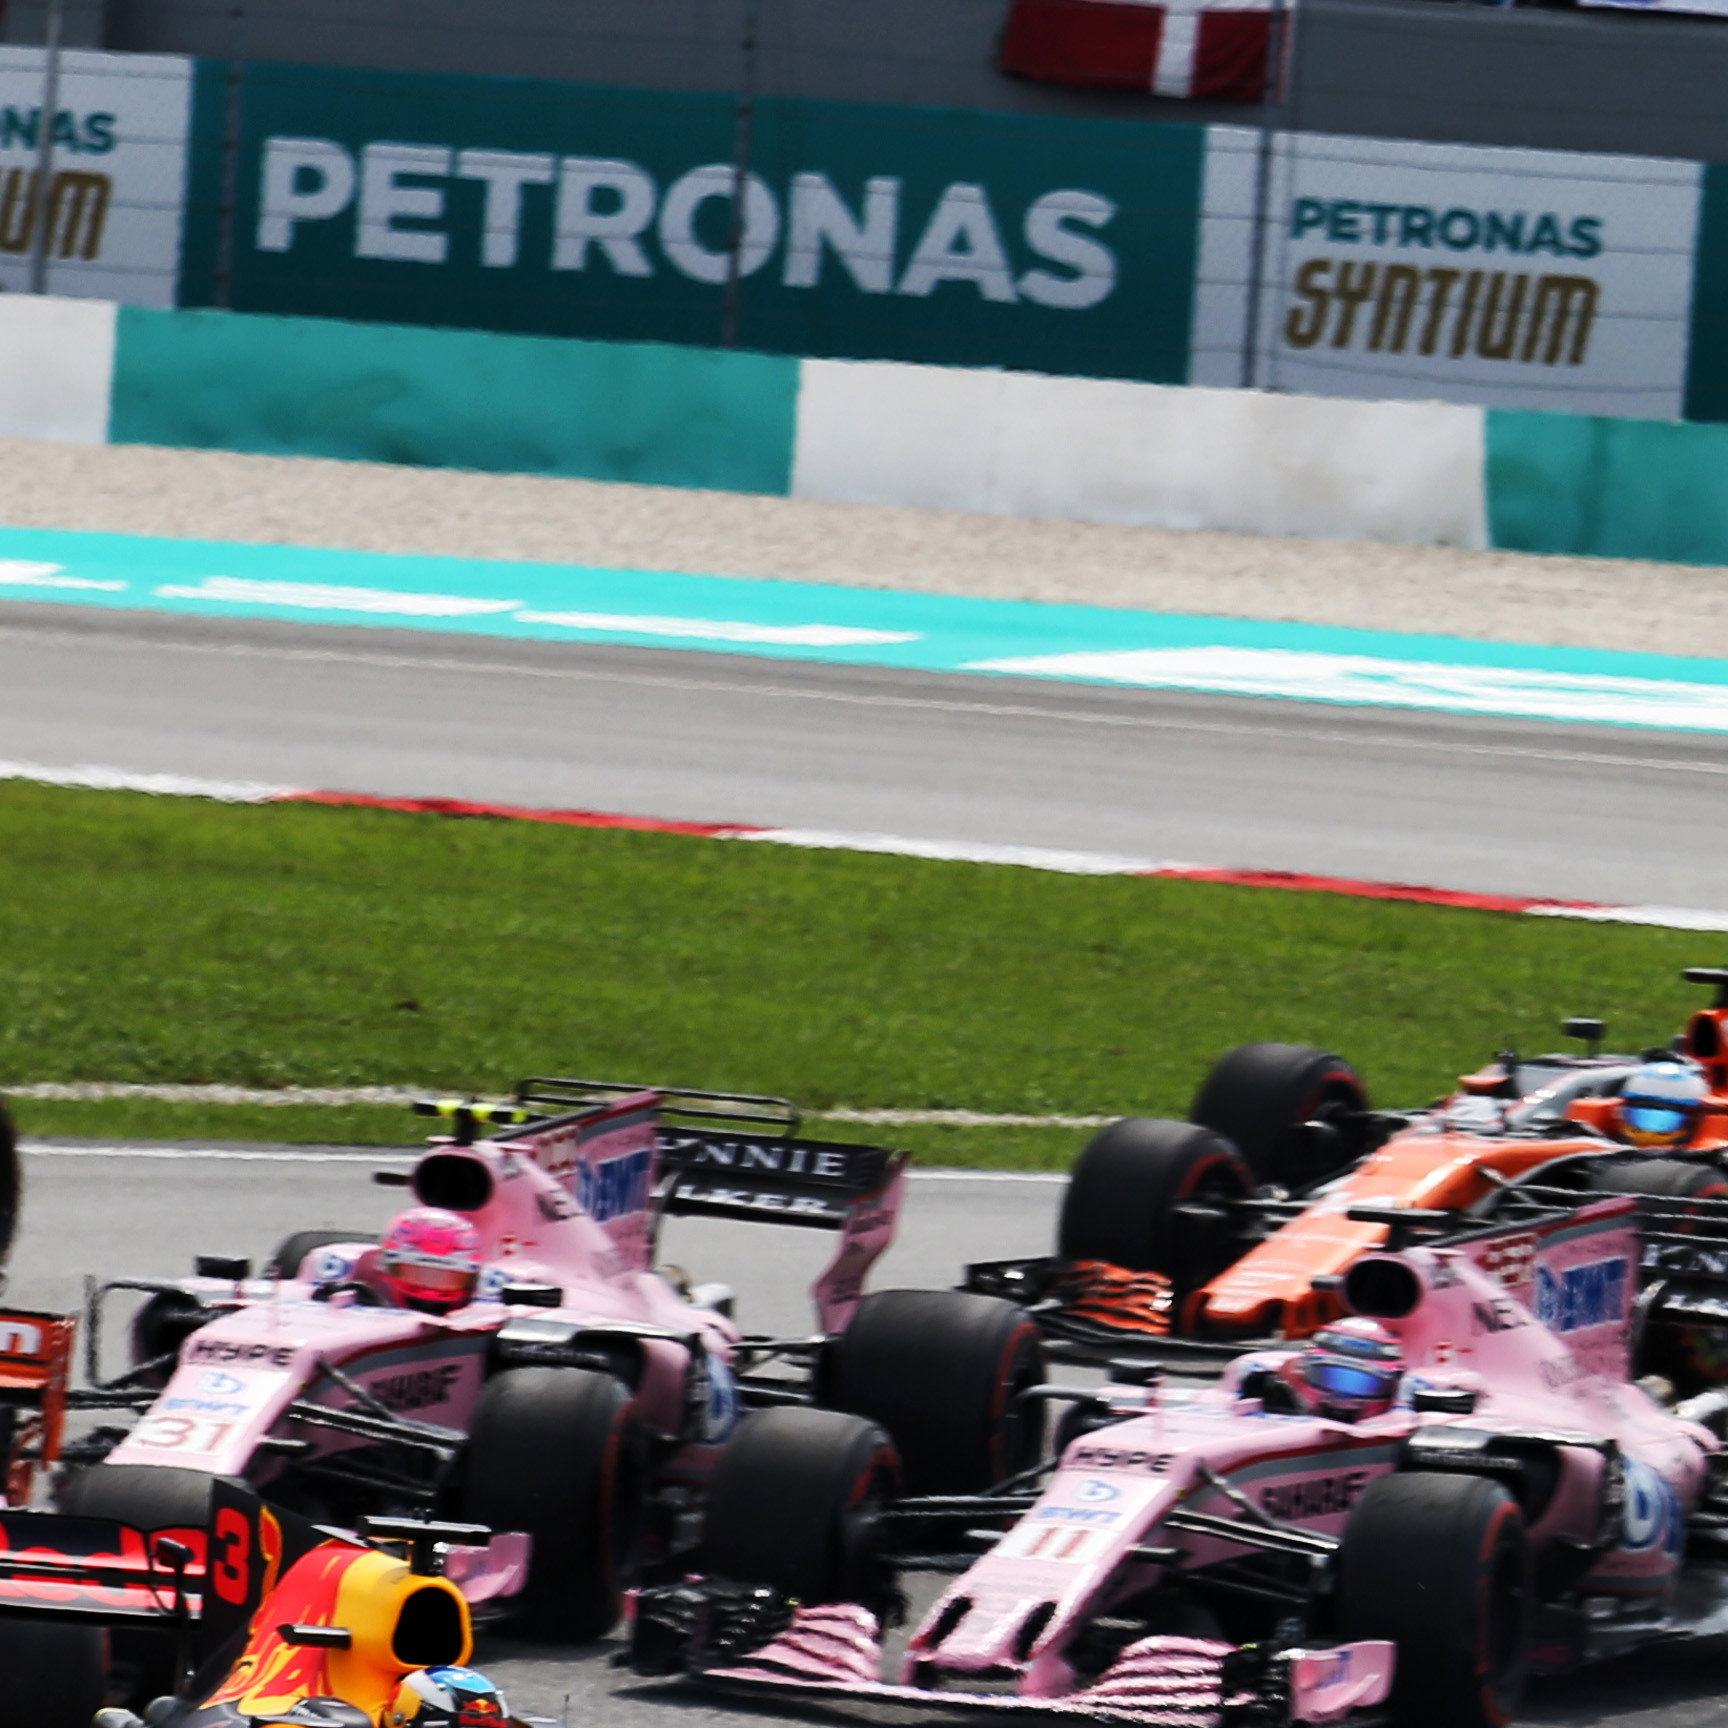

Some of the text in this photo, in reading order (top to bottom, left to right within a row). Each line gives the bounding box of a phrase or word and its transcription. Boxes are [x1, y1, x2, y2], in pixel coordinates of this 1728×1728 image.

[256, 136, 1118, 310] PETRONAS
[1290, 199, 1602, 259] PETRONAS
[1285, 257, 1600, 367] SYNTIUM
[140, 1415, 238, 1450] 31
[213, 1508, 251, 1605] 3
